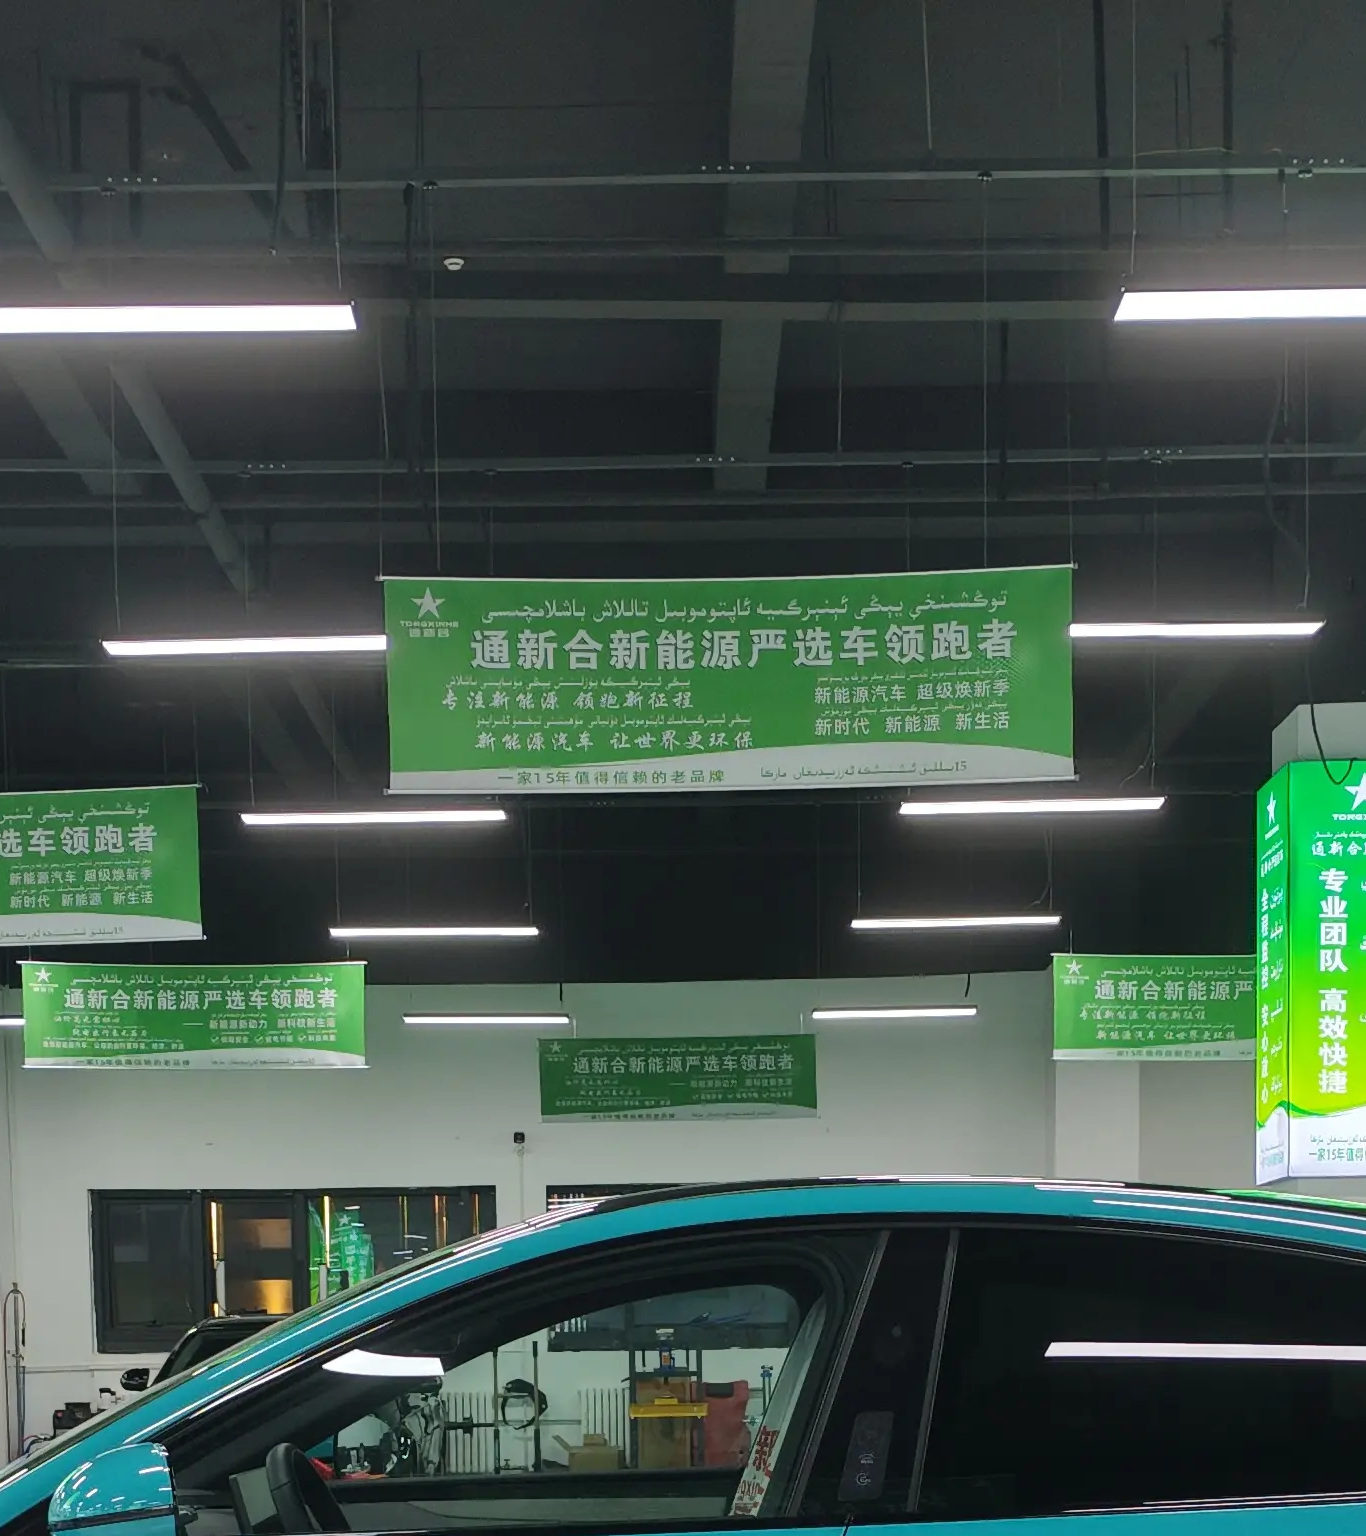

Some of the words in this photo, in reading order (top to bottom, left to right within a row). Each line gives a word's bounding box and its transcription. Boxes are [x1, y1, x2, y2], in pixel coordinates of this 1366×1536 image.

[470, 618, 1018, 671] 通新合新能源严选车领跑者
[442, 690, 559, 711] 专注新能源
[573, 690, 695, 710] 领跑新征程
[814, 684, 907, 704] 新能源汽车
[916, 678, 1010, 701] 超级焕新季
[814, 718, 871, 736] 新时代
[884, 714, 941, 734] 新能源
[955, 711, 1010, 730] 新生活
[475, 730, 594, 752] 新能源汽车
[609, 729, 754, 751] 让世界更环保
[497, 769, 726, 785] 一家15年值得信赖的老品牌
[9, 869, 77, 885] 新能源汽车
[10, 893, 50, 909] 新时代
[61, 892, 102, 907] 新能源
[112, 890, 154, 905] 新生活
[1318, 867, 1349, 974] 专业团队
[63, 987, 339, 1012] 通新合新能源严选车领跑者
[1094, 979, 1254, 1001] 通新合新能源严
[1318, 988, 1349, 1094] 高效快捷
[573, 1053, 795, 1075] 通新合新能源严选车领跑者
